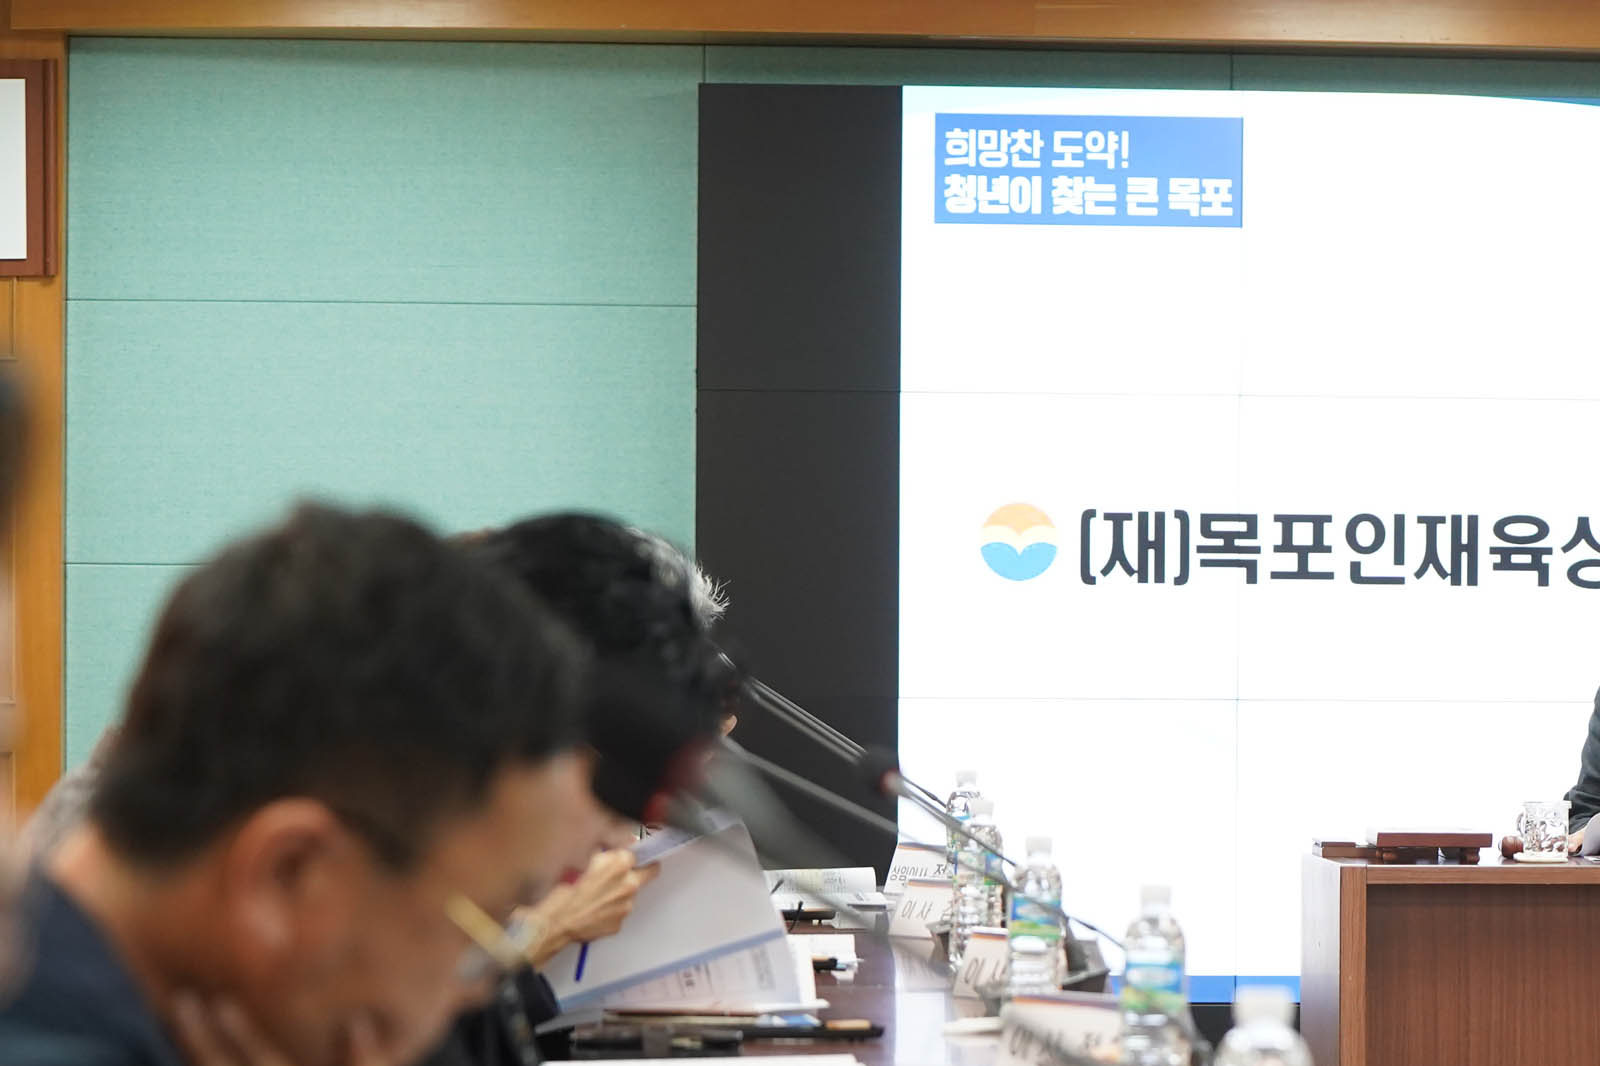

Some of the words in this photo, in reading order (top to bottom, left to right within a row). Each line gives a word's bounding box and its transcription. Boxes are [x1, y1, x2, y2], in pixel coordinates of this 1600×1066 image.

[944, 128, 1044, 168] 희망찬
[1051, 130, 1129, 169] 도약!
[944, 174, 1042, 215] 청년이
[1051, 175, 1117, 216] 찾는
[1125, 177, 1160, 217] 큰
[1167, 178, 1234, 217] 목포
